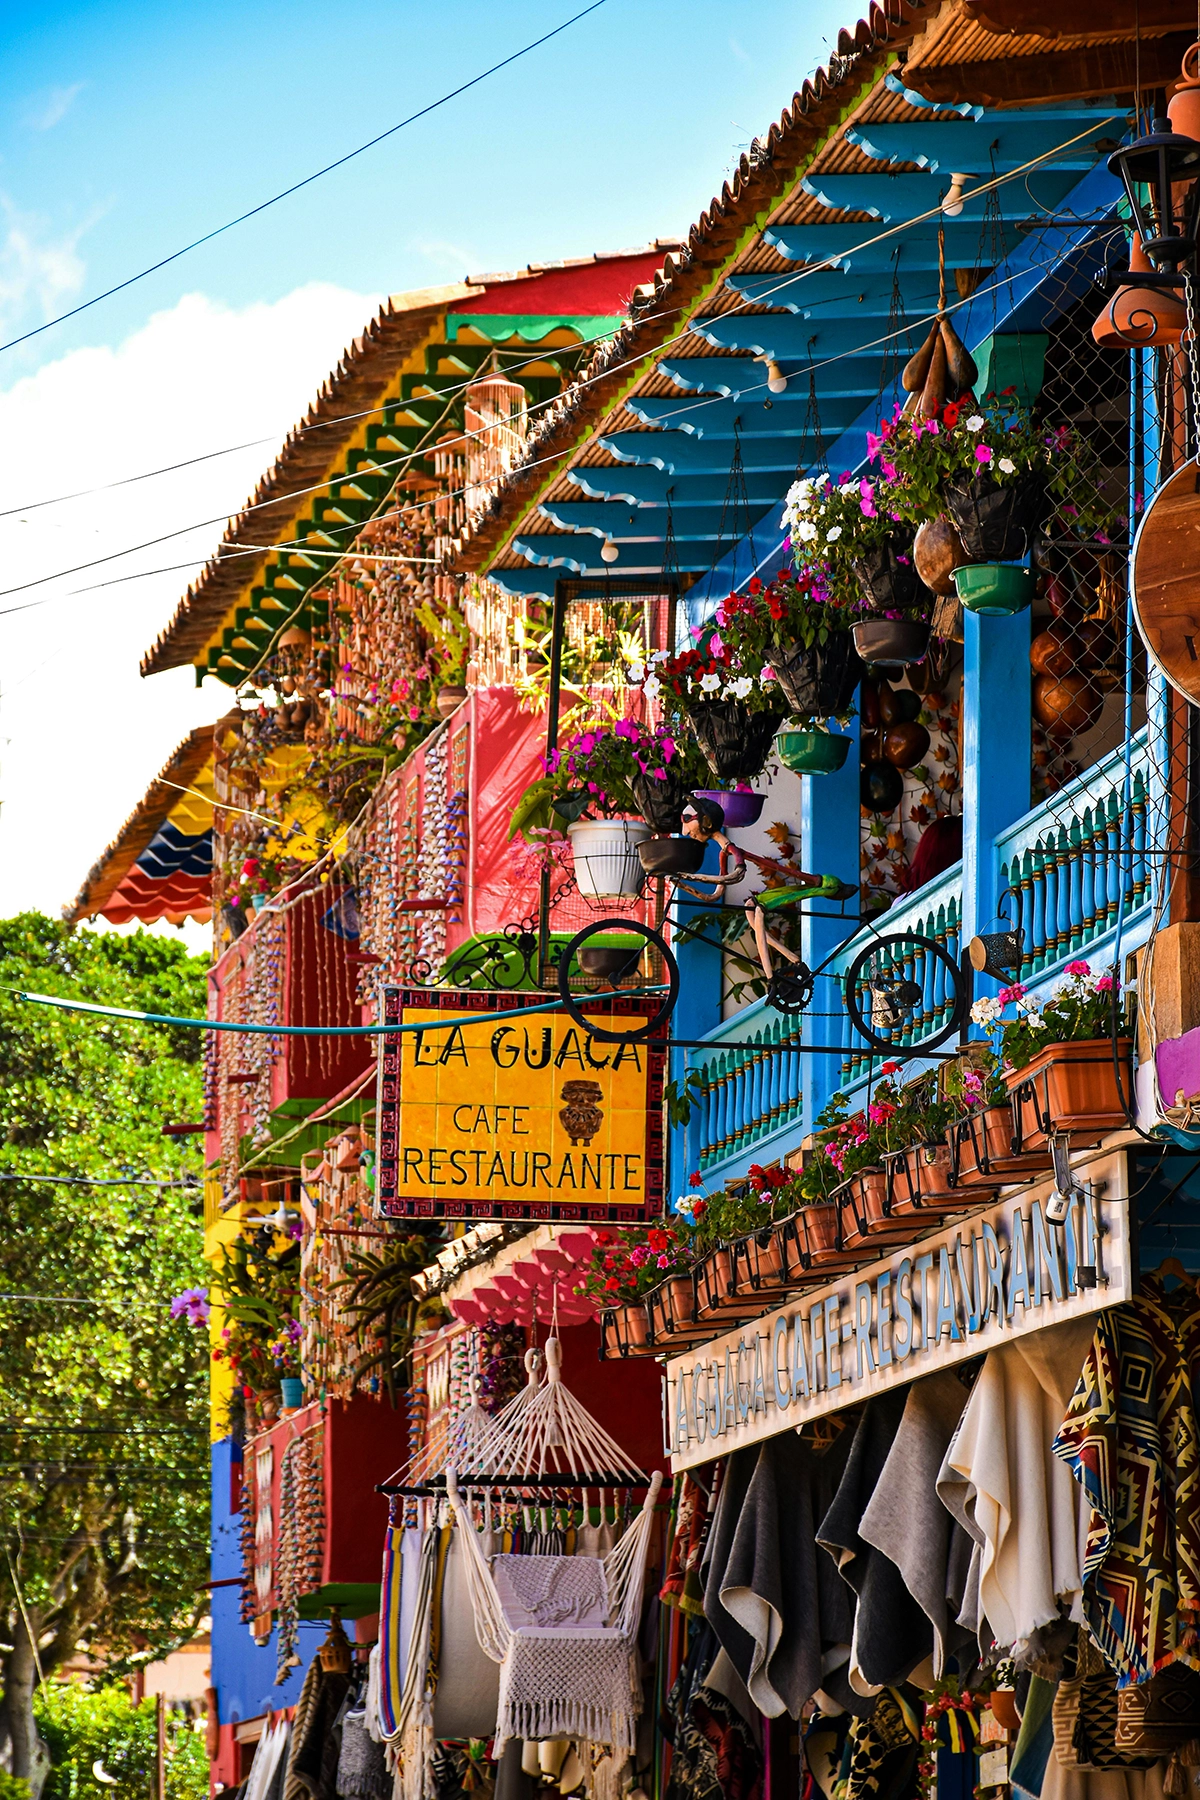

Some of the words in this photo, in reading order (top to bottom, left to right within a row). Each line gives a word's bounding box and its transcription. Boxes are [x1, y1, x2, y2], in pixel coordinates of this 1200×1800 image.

[413, 1023, 469, 1067] LA
[490, 1026, 642, 1073] GUACA
[452, 1104, 530, 1135] CAFE
[402, 1147, 641, 1191] RESTAURANTE
